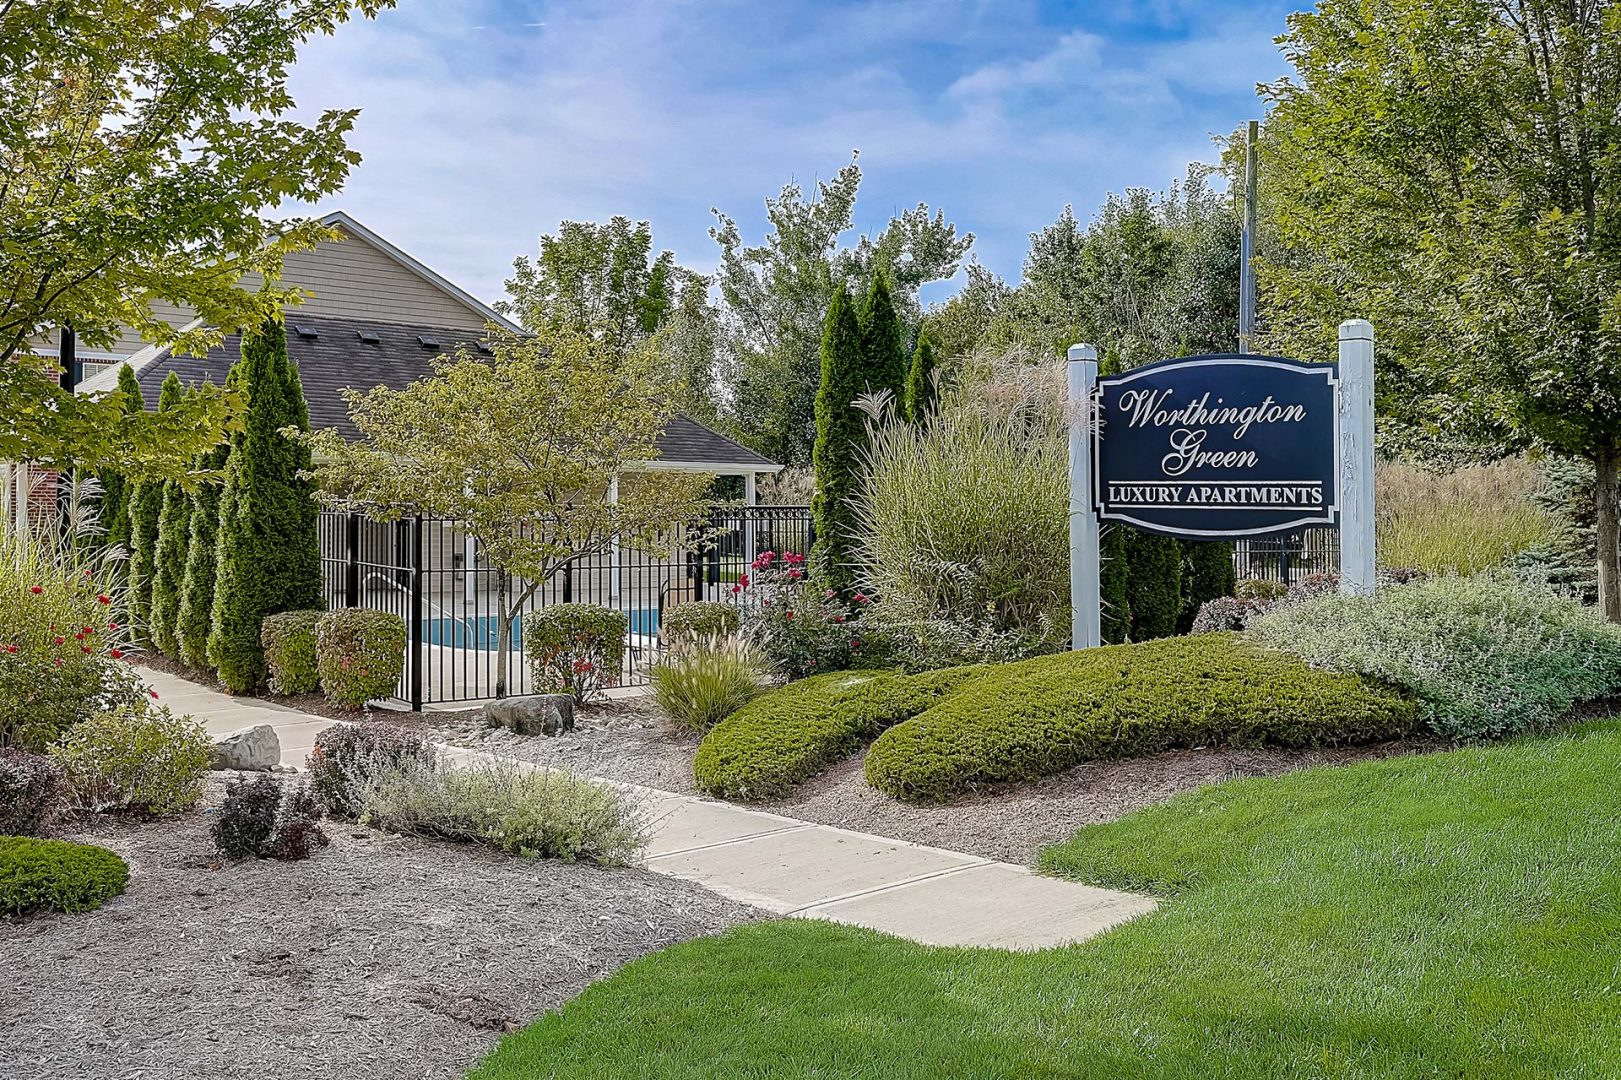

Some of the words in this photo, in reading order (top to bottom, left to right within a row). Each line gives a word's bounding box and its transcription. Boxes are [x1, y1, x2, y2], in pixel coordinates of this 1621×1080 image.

[1118, 388, 1307, 440] Worthington
[1161, 428, 1259, 477] Green
[1108, 486, 1183, 503] LUXURY
[1186, 486, 1323, 505] APARTMENTS
